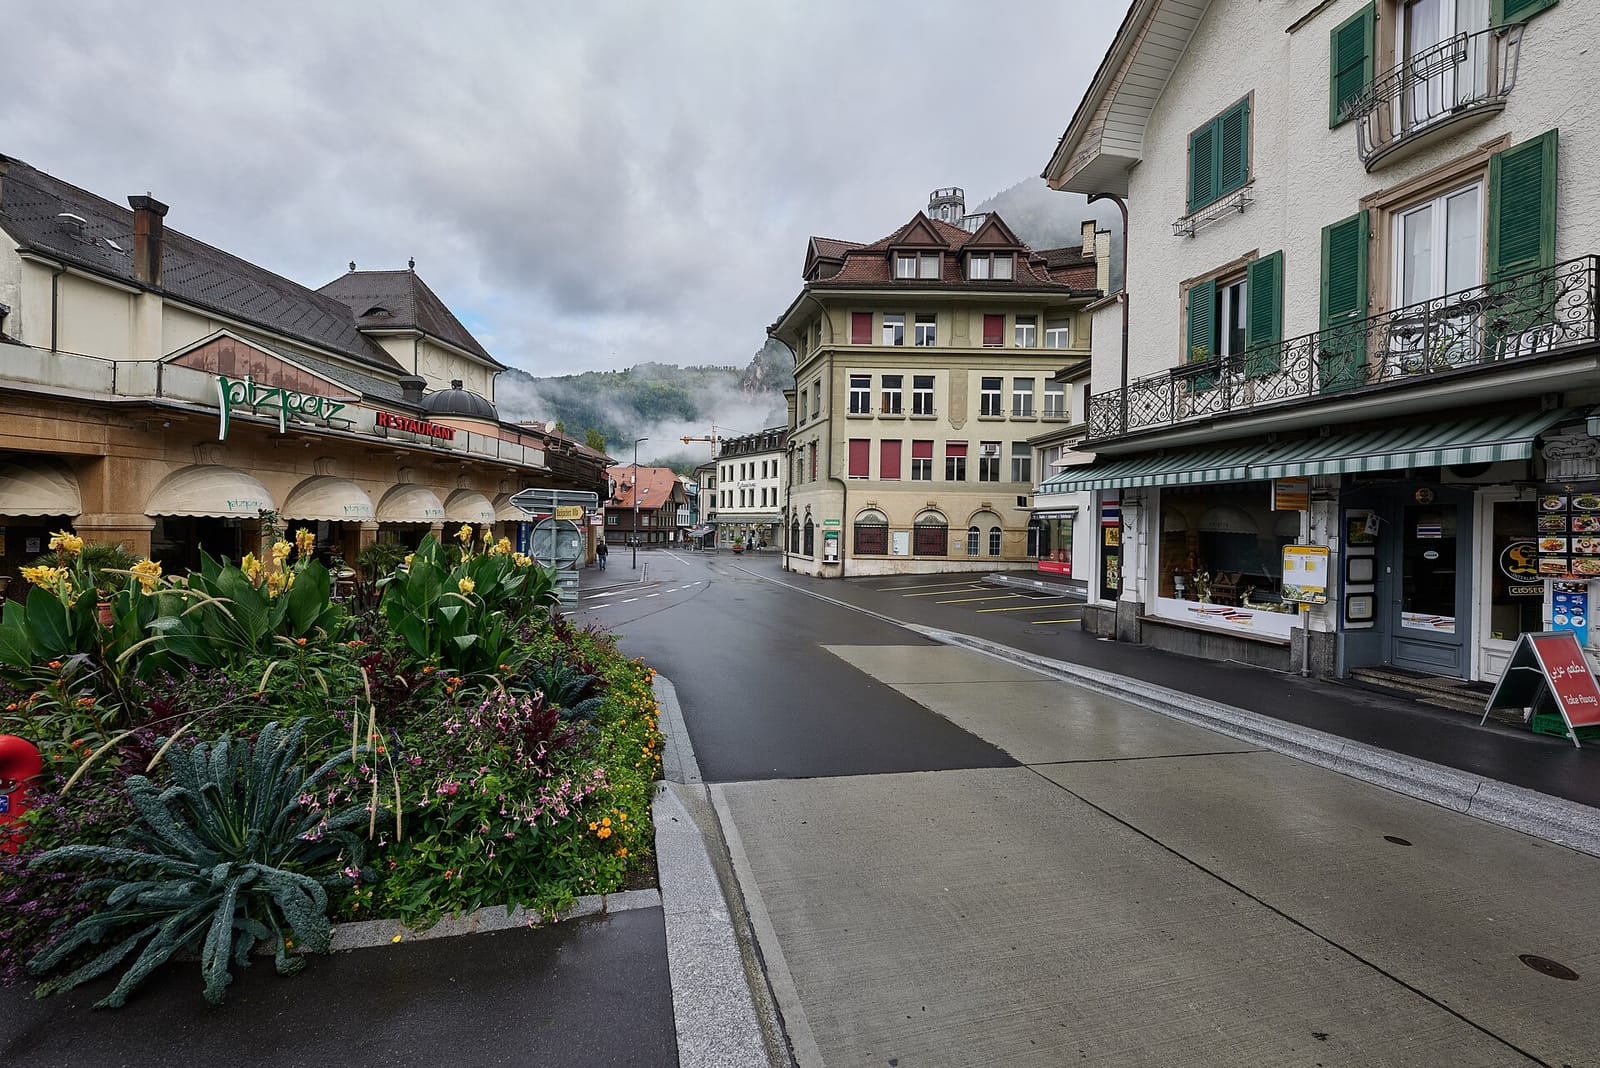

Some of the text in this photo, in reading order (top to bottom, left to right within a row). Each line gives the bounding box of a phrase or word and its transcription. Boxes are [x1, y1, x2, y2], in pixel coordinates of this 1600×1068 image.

[215, 375, 357, 441] pizpaz
[377, 411, 457, 441] RESTAURANT
[1511, 586, 1545, 594] CLOSED
[1563, 694, 1599, 706] Take Away
